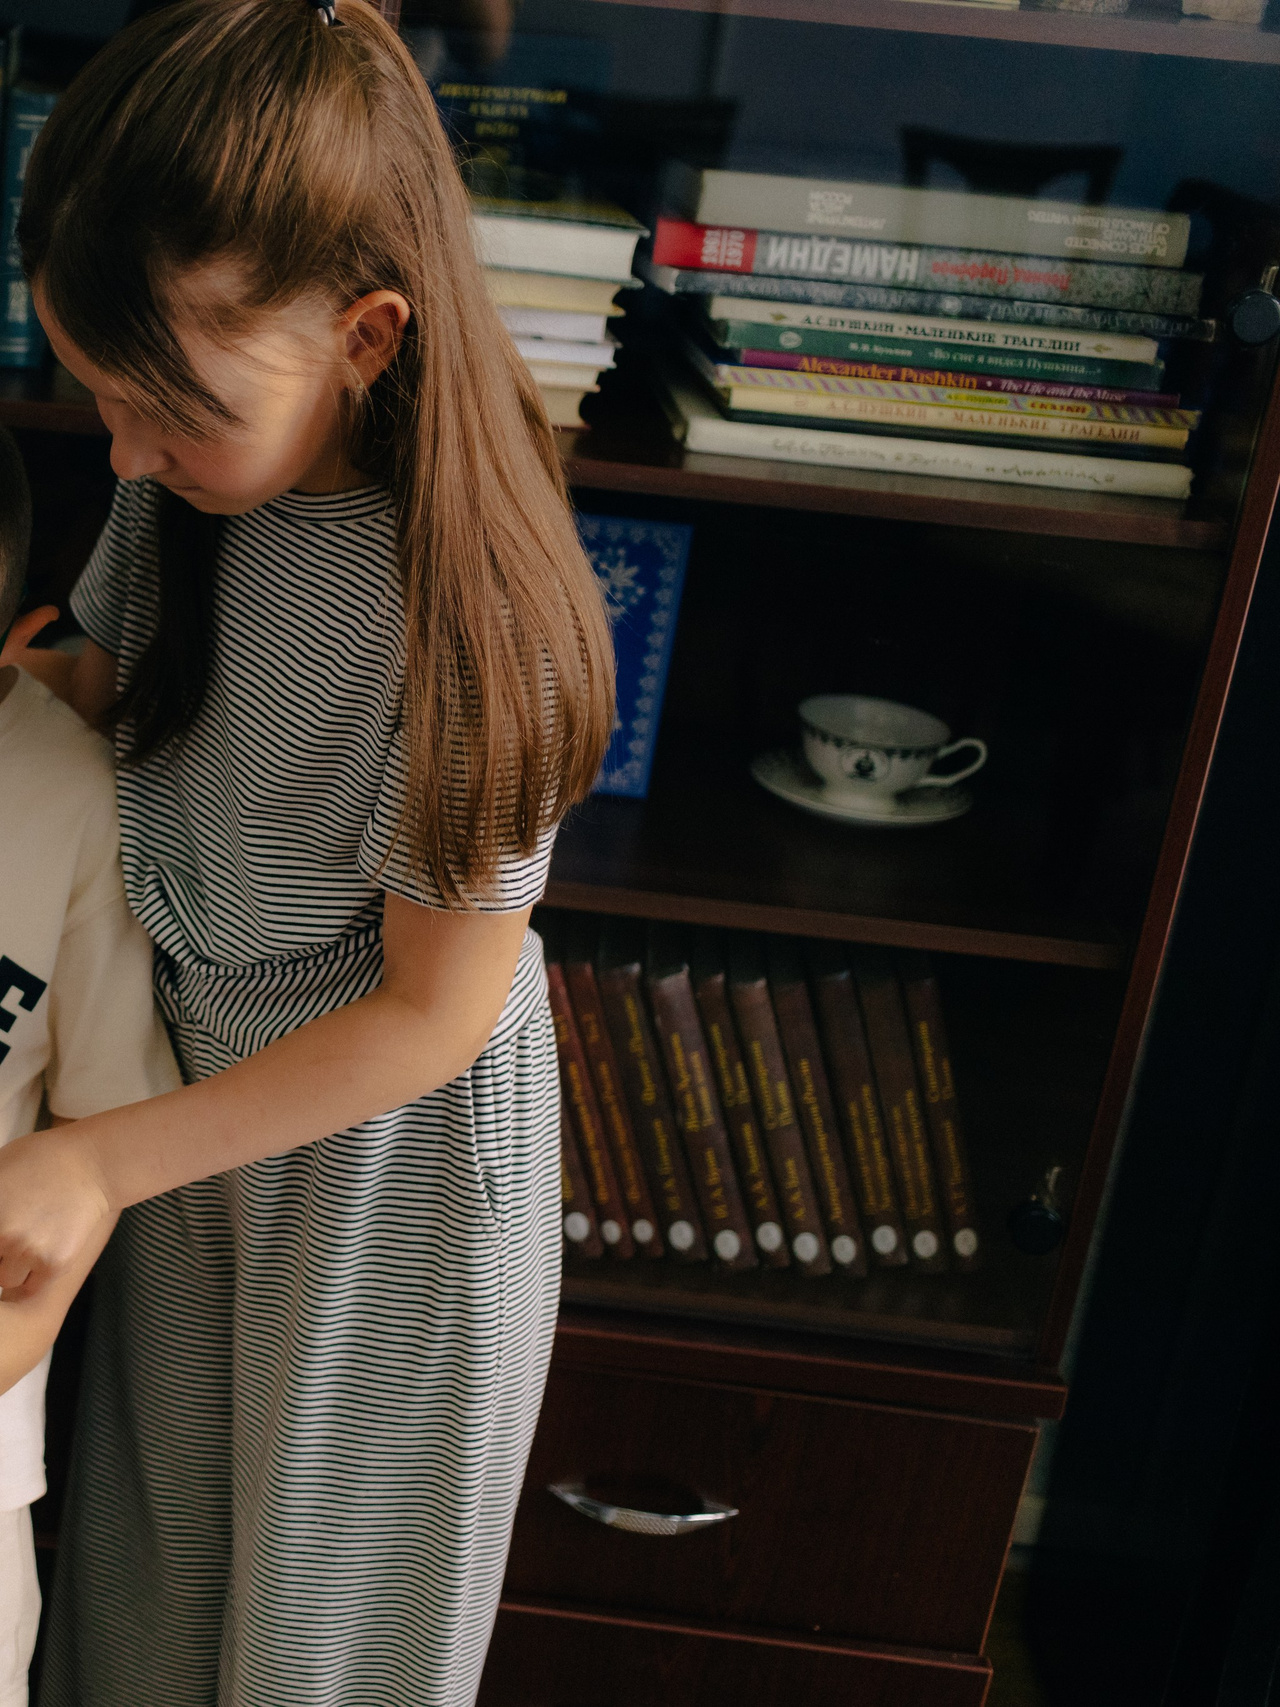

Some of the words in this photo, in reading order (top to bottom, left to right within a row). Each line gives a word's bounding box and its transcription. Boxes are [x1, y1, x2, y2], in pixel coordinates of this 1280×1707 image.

[765, 236, 919, 282] НАМЕДНИ
[821, 317, 895, 334] ПУШКИН
[905, 324, 996, 346] МАЛЕНЬКИЕ
[1002, 334, 1081, 353] ТРАГЕДИИ
[797, 356, 897, 381] Alexander
[900, 368, 978, 390] Pushkin
[1000, 378, 1020, 392] The
[1021, 381, 1045, 396] Life
[1047, 384, 1071, 398] and
[1071, 386, 1091, 400] the
[1092, 389, 1126, 403] Muse
[858, 402, 928, 420] ПУШКИН
[953, 412, 1051, 433] МАЛЕНЬКИЕ
[1060, 423, 1141, 442] ТРАГЕДИИ
